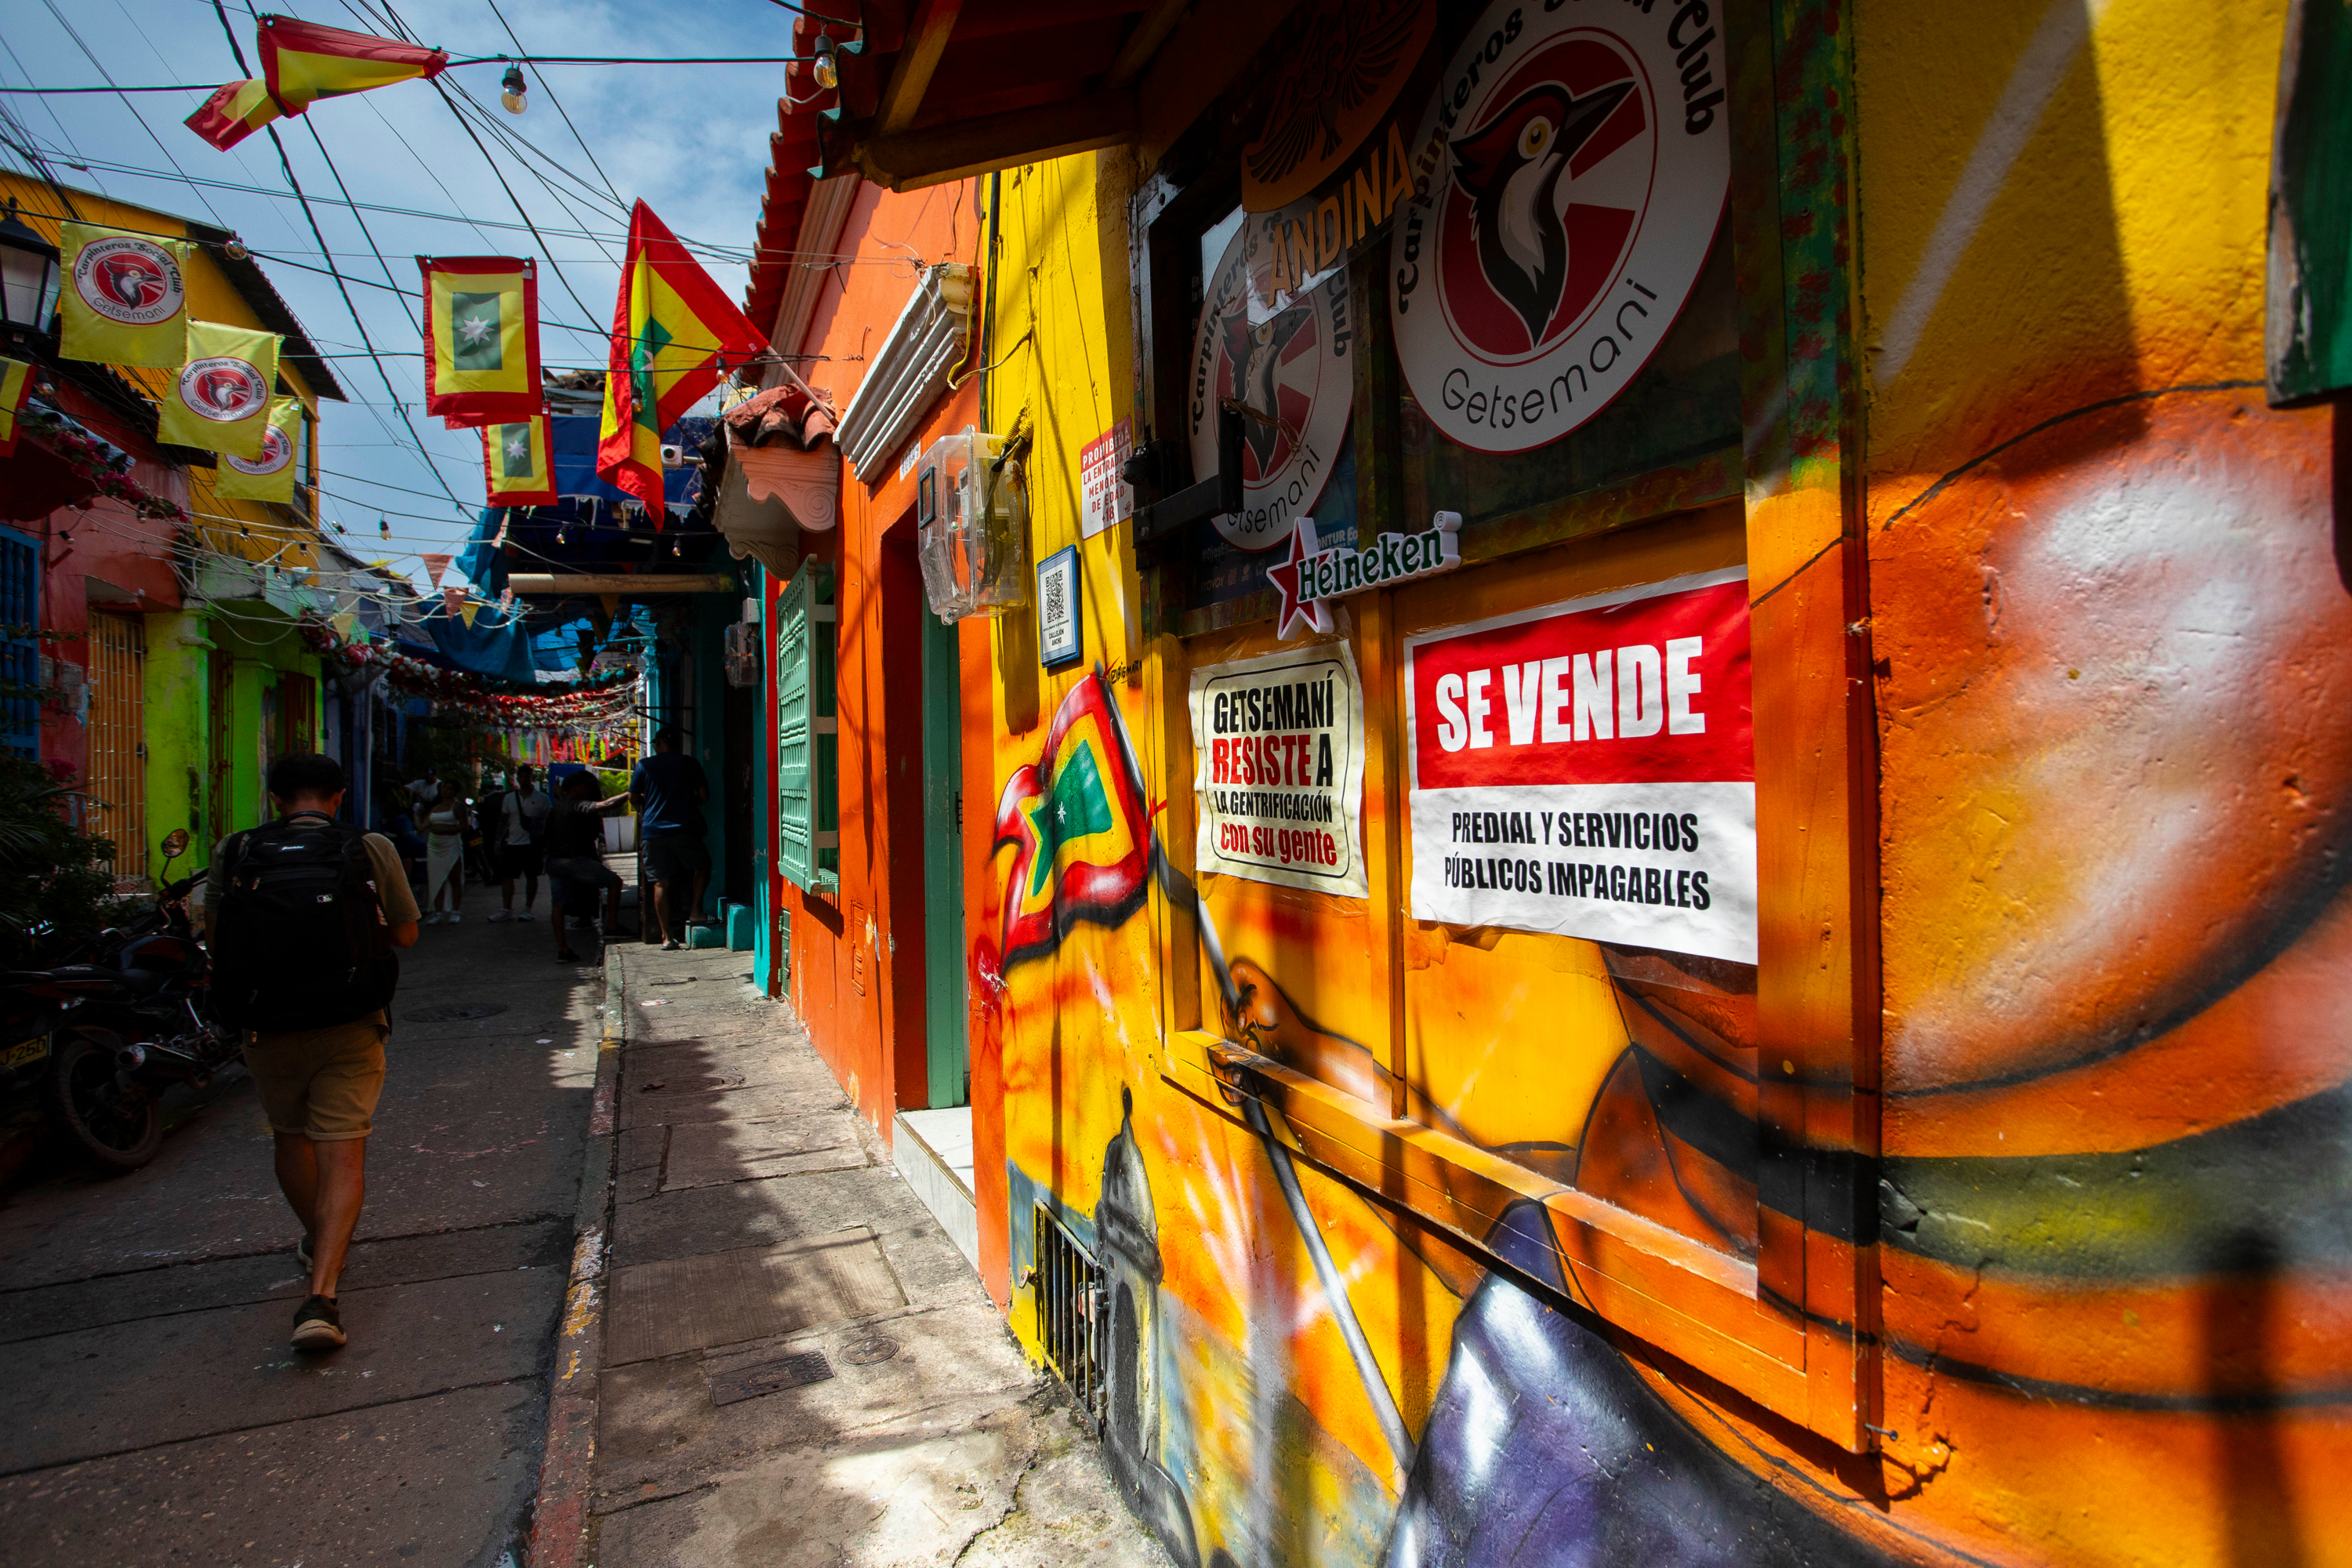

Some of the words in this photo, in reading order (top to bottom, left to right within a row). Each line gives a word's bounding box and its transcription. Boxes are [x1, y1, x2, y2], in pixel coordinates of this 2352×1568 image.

[1398, 8, 1523, 314] Carpinteros
[1668, 0, 1724, 135] Club
[1267, 118, 1416, 310] ANDINA
[77, 242, 131, 279] Carpinteros
[134, 242, 173, 266] Social
[169, 267, 183, 293] Club
[1443, 278, 1657, 429] Getsemani
[181, 361, 229, 386] Carpinteros
[230, 361, 259, 380] Social
[255, 380, 264, 400] Club
[1082, 426, 1131, 469] PROHIBIDA
[1083, 471, 1091, 485] LA
[1093, 452, 1123, 480] ENTRADA
[1126, 445, 1131, 459] A
[1088, 467, 1124, 499] MENORES
[1091, 498, 1101, 514] DE
[1104, 485, 1124, 507] EDAD
[1227, 444, 1320, 534] etsemani
[1102, 505, 1115, 523] +18
[1298, 528, 1444, 602] Heineken
[1213, 669, 1336, 735] GETSEMANÍ
[1436, 668, 1494, 753] SE
[1502, 635, 1706, 746] VENDE
[1212, 734, 1312, 786] RESISTE
[1316, 733, 1333, 786] A
[1214, 790, 1229, 815] LA
[1230, 789, 1333, 823] GENTRIFICACIÓN
[1220, 822, 1250, 854] con
[1252, 826, 1276, 858] su
[1278, 828, 1338, 866] gente
[1451, 811, 1537, 844] PREDIAL
[1540, 811, 1554, 845] Y
[1558, 811, 1700, 853] SERVICIOS
[1444, 851, 1543, 895] PÚBLICOS
[1547, 861, 1711, 911] IMPAGABLES
